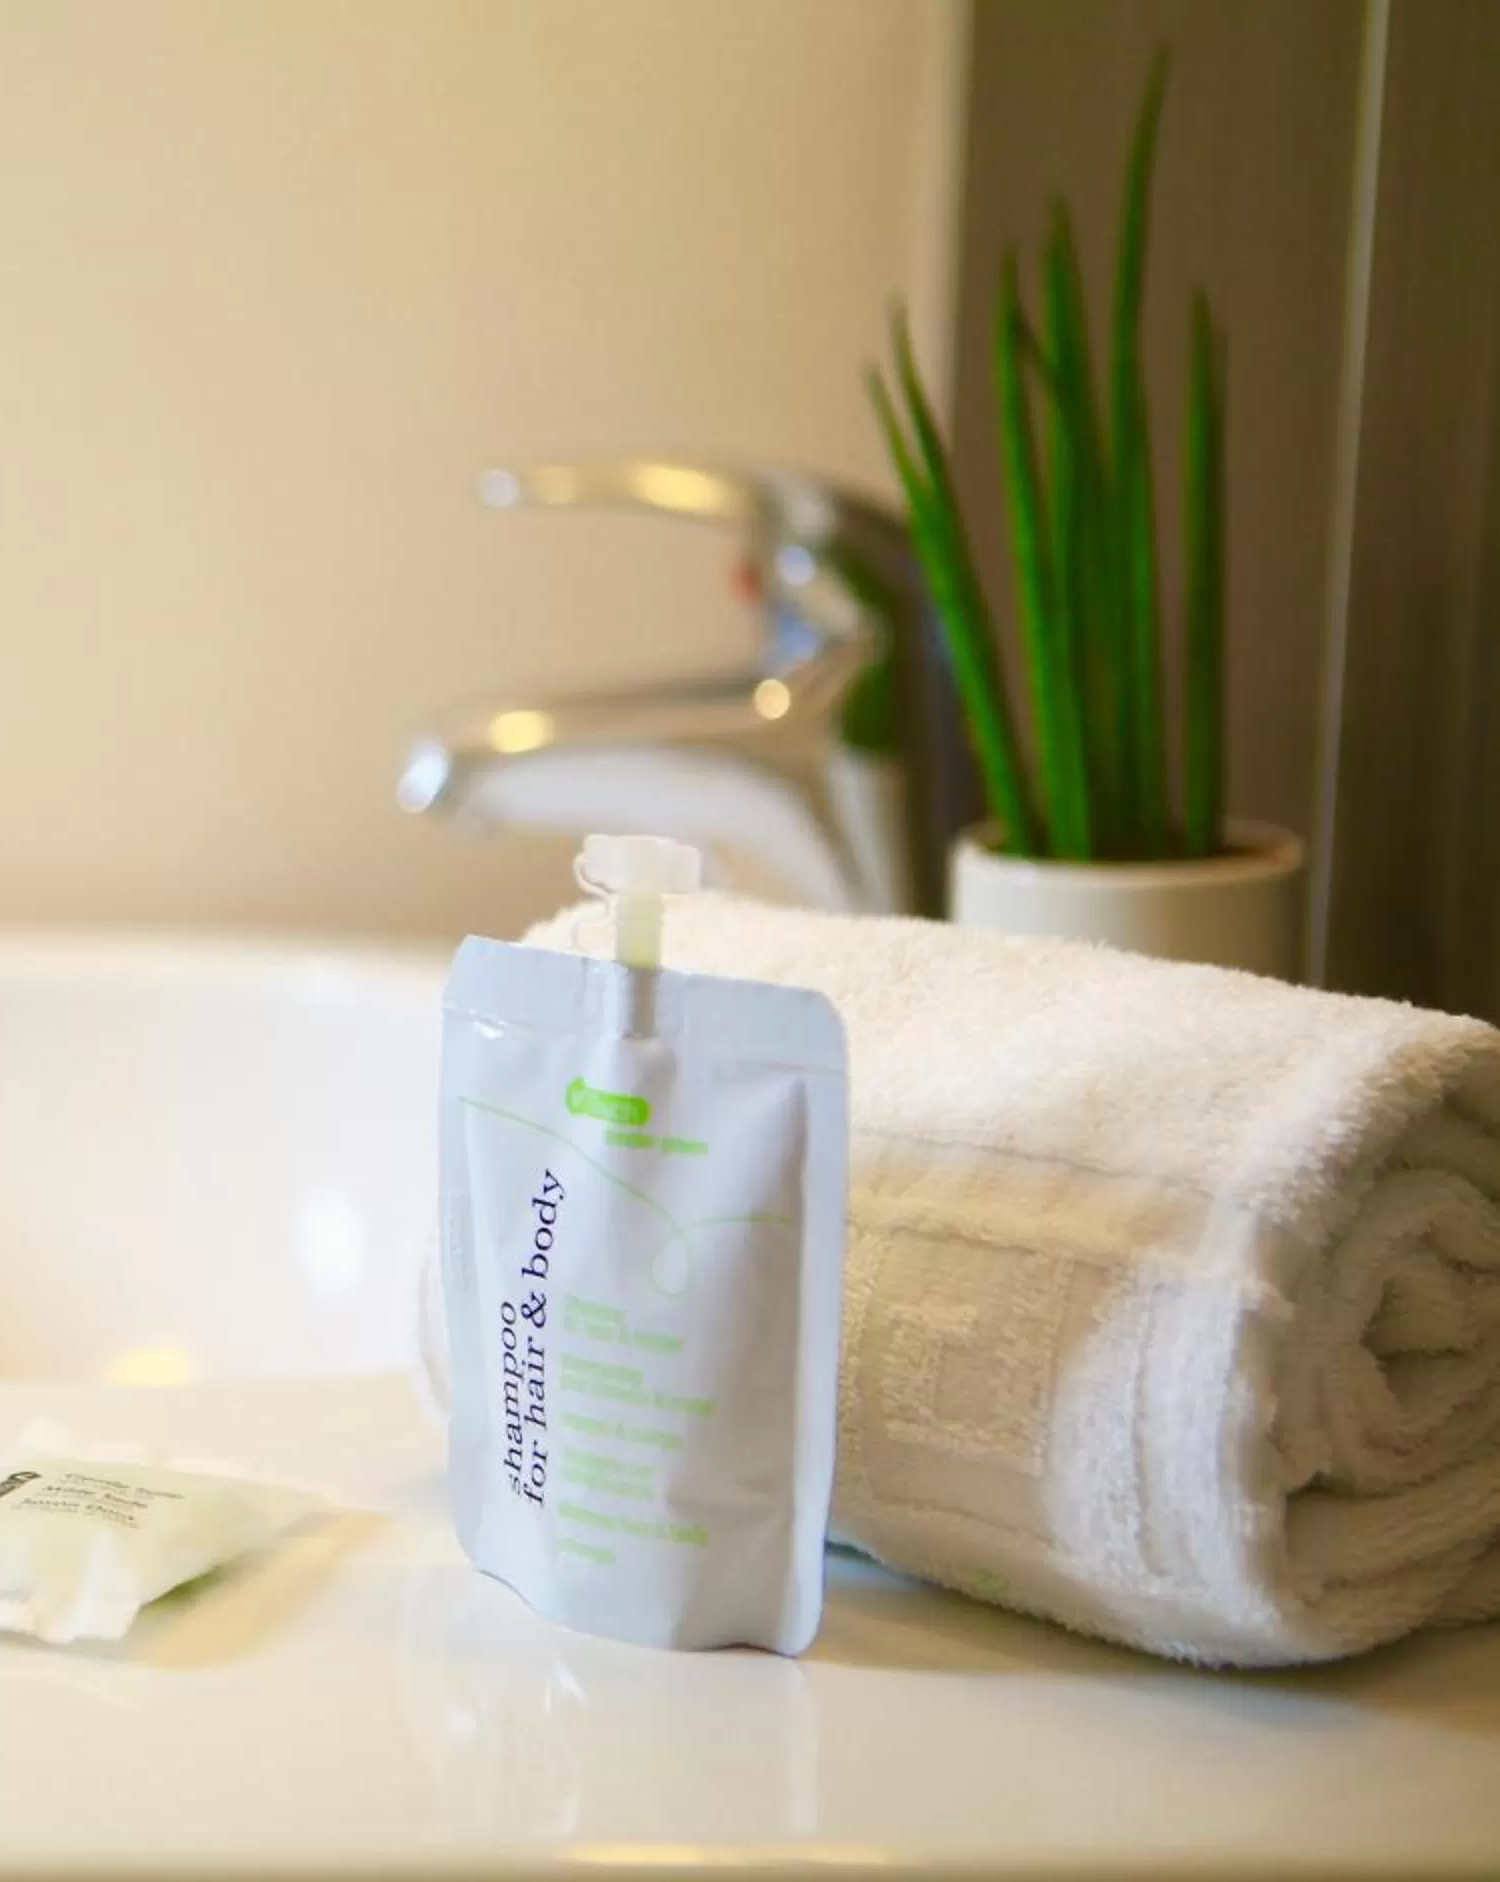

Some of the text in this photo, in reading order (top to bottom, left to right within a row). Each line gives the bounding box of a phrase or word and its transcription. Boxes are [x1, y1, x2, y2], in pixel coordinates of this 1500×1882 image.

[500, 1301, 524, 1496] shampoo
[520, 1168, 565, 1508] for hair & body
